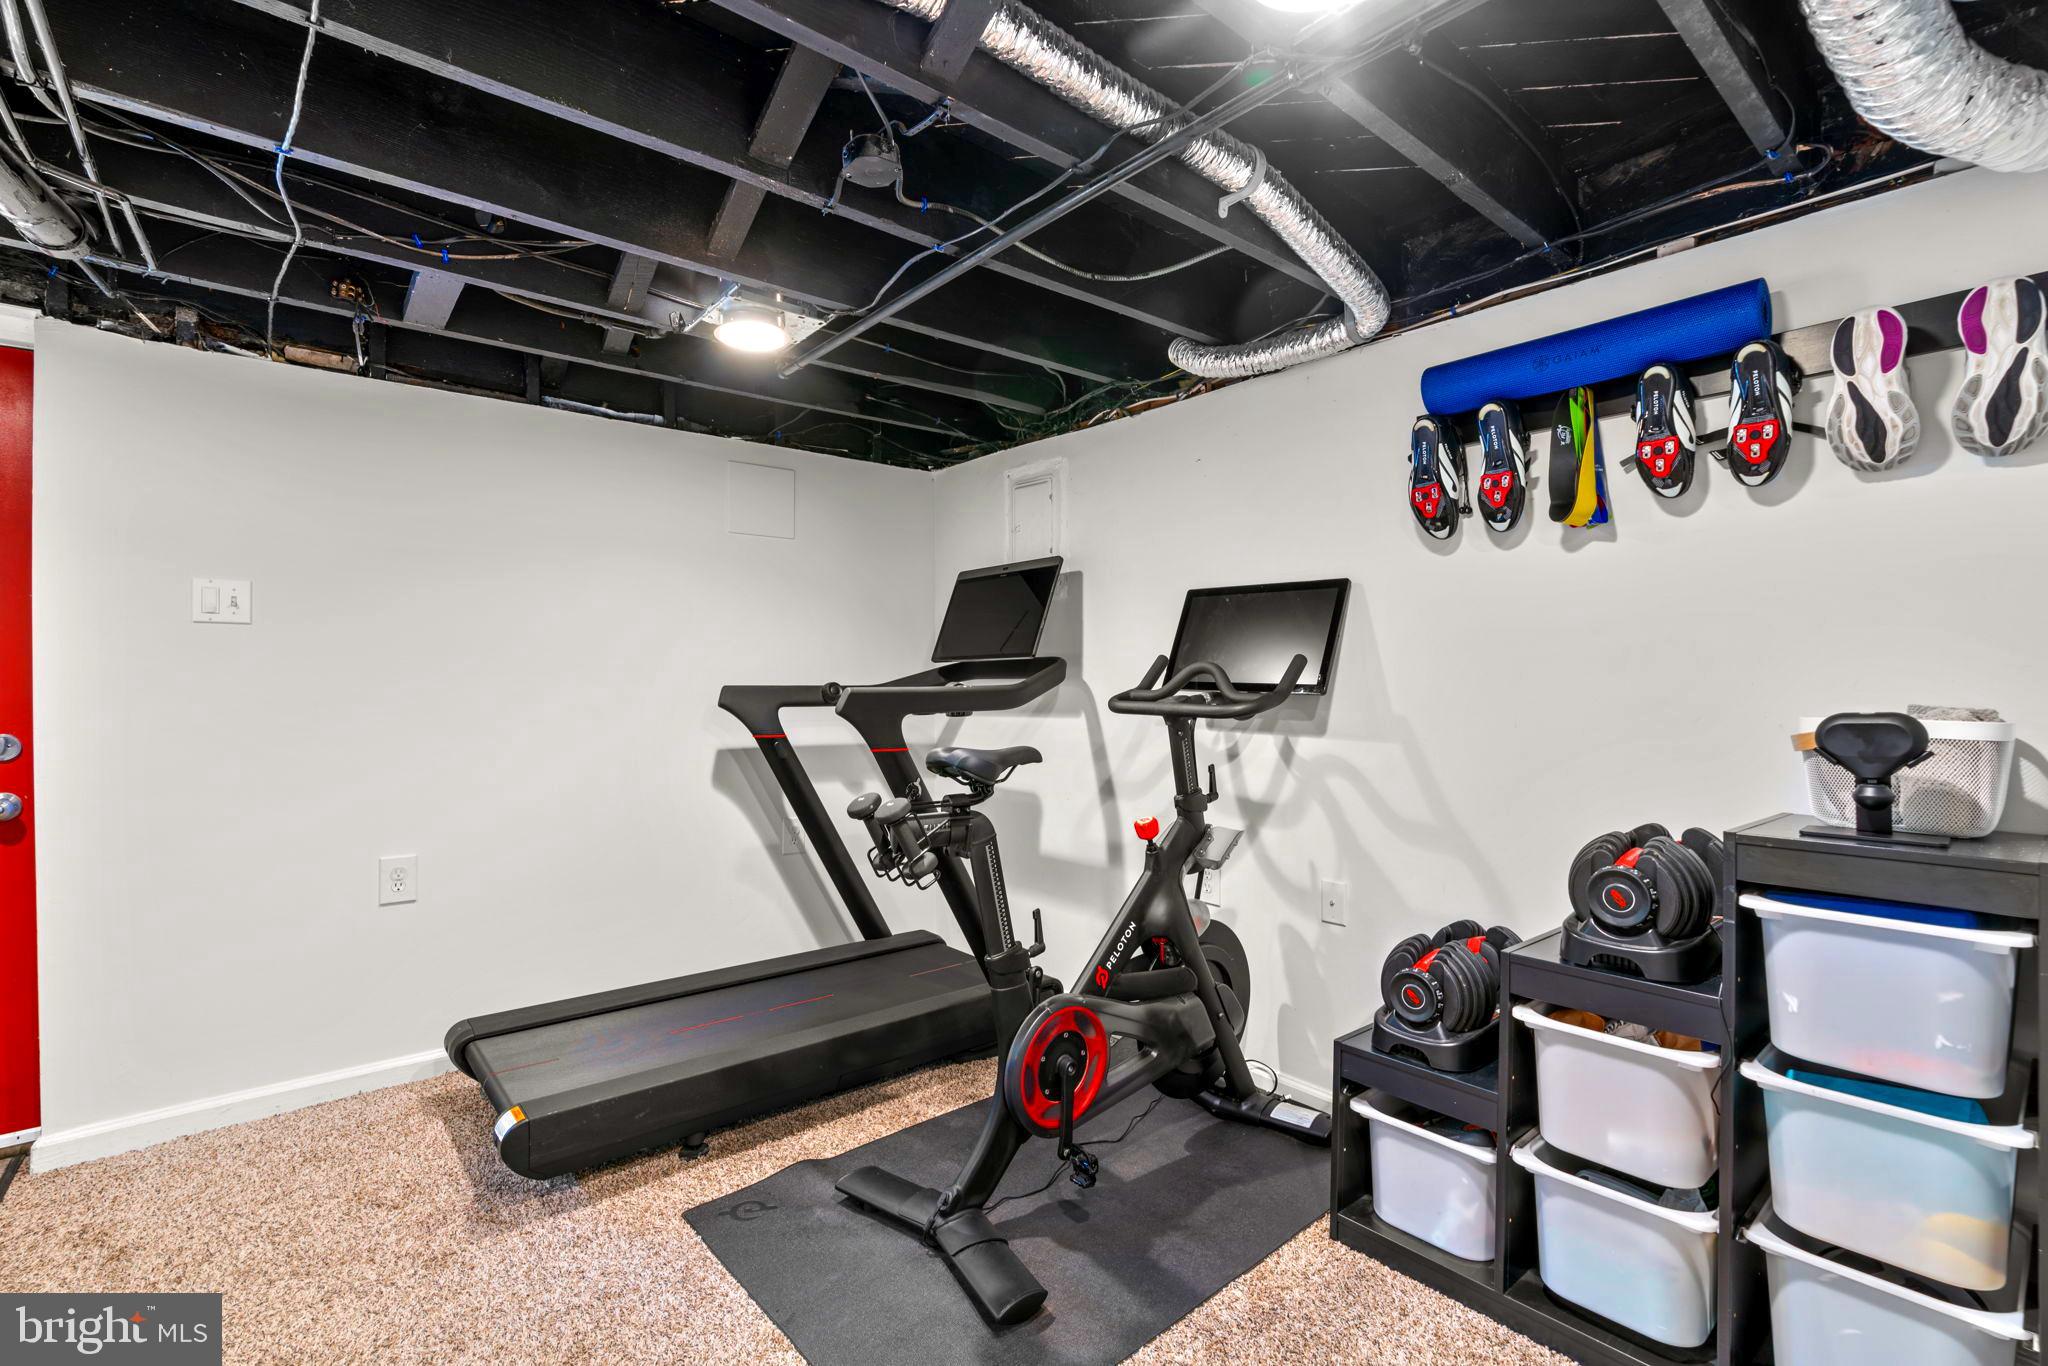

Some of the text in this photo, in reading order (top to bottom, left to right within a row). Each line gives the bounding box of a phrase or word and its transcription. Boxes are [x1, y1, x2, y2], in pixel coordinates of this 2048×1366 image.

[1752, 370, 1760, 396] PELOTON
[1490, 425, 1499, 450] PELOTON
[1105, 921, 1137, 970] PELOTON
